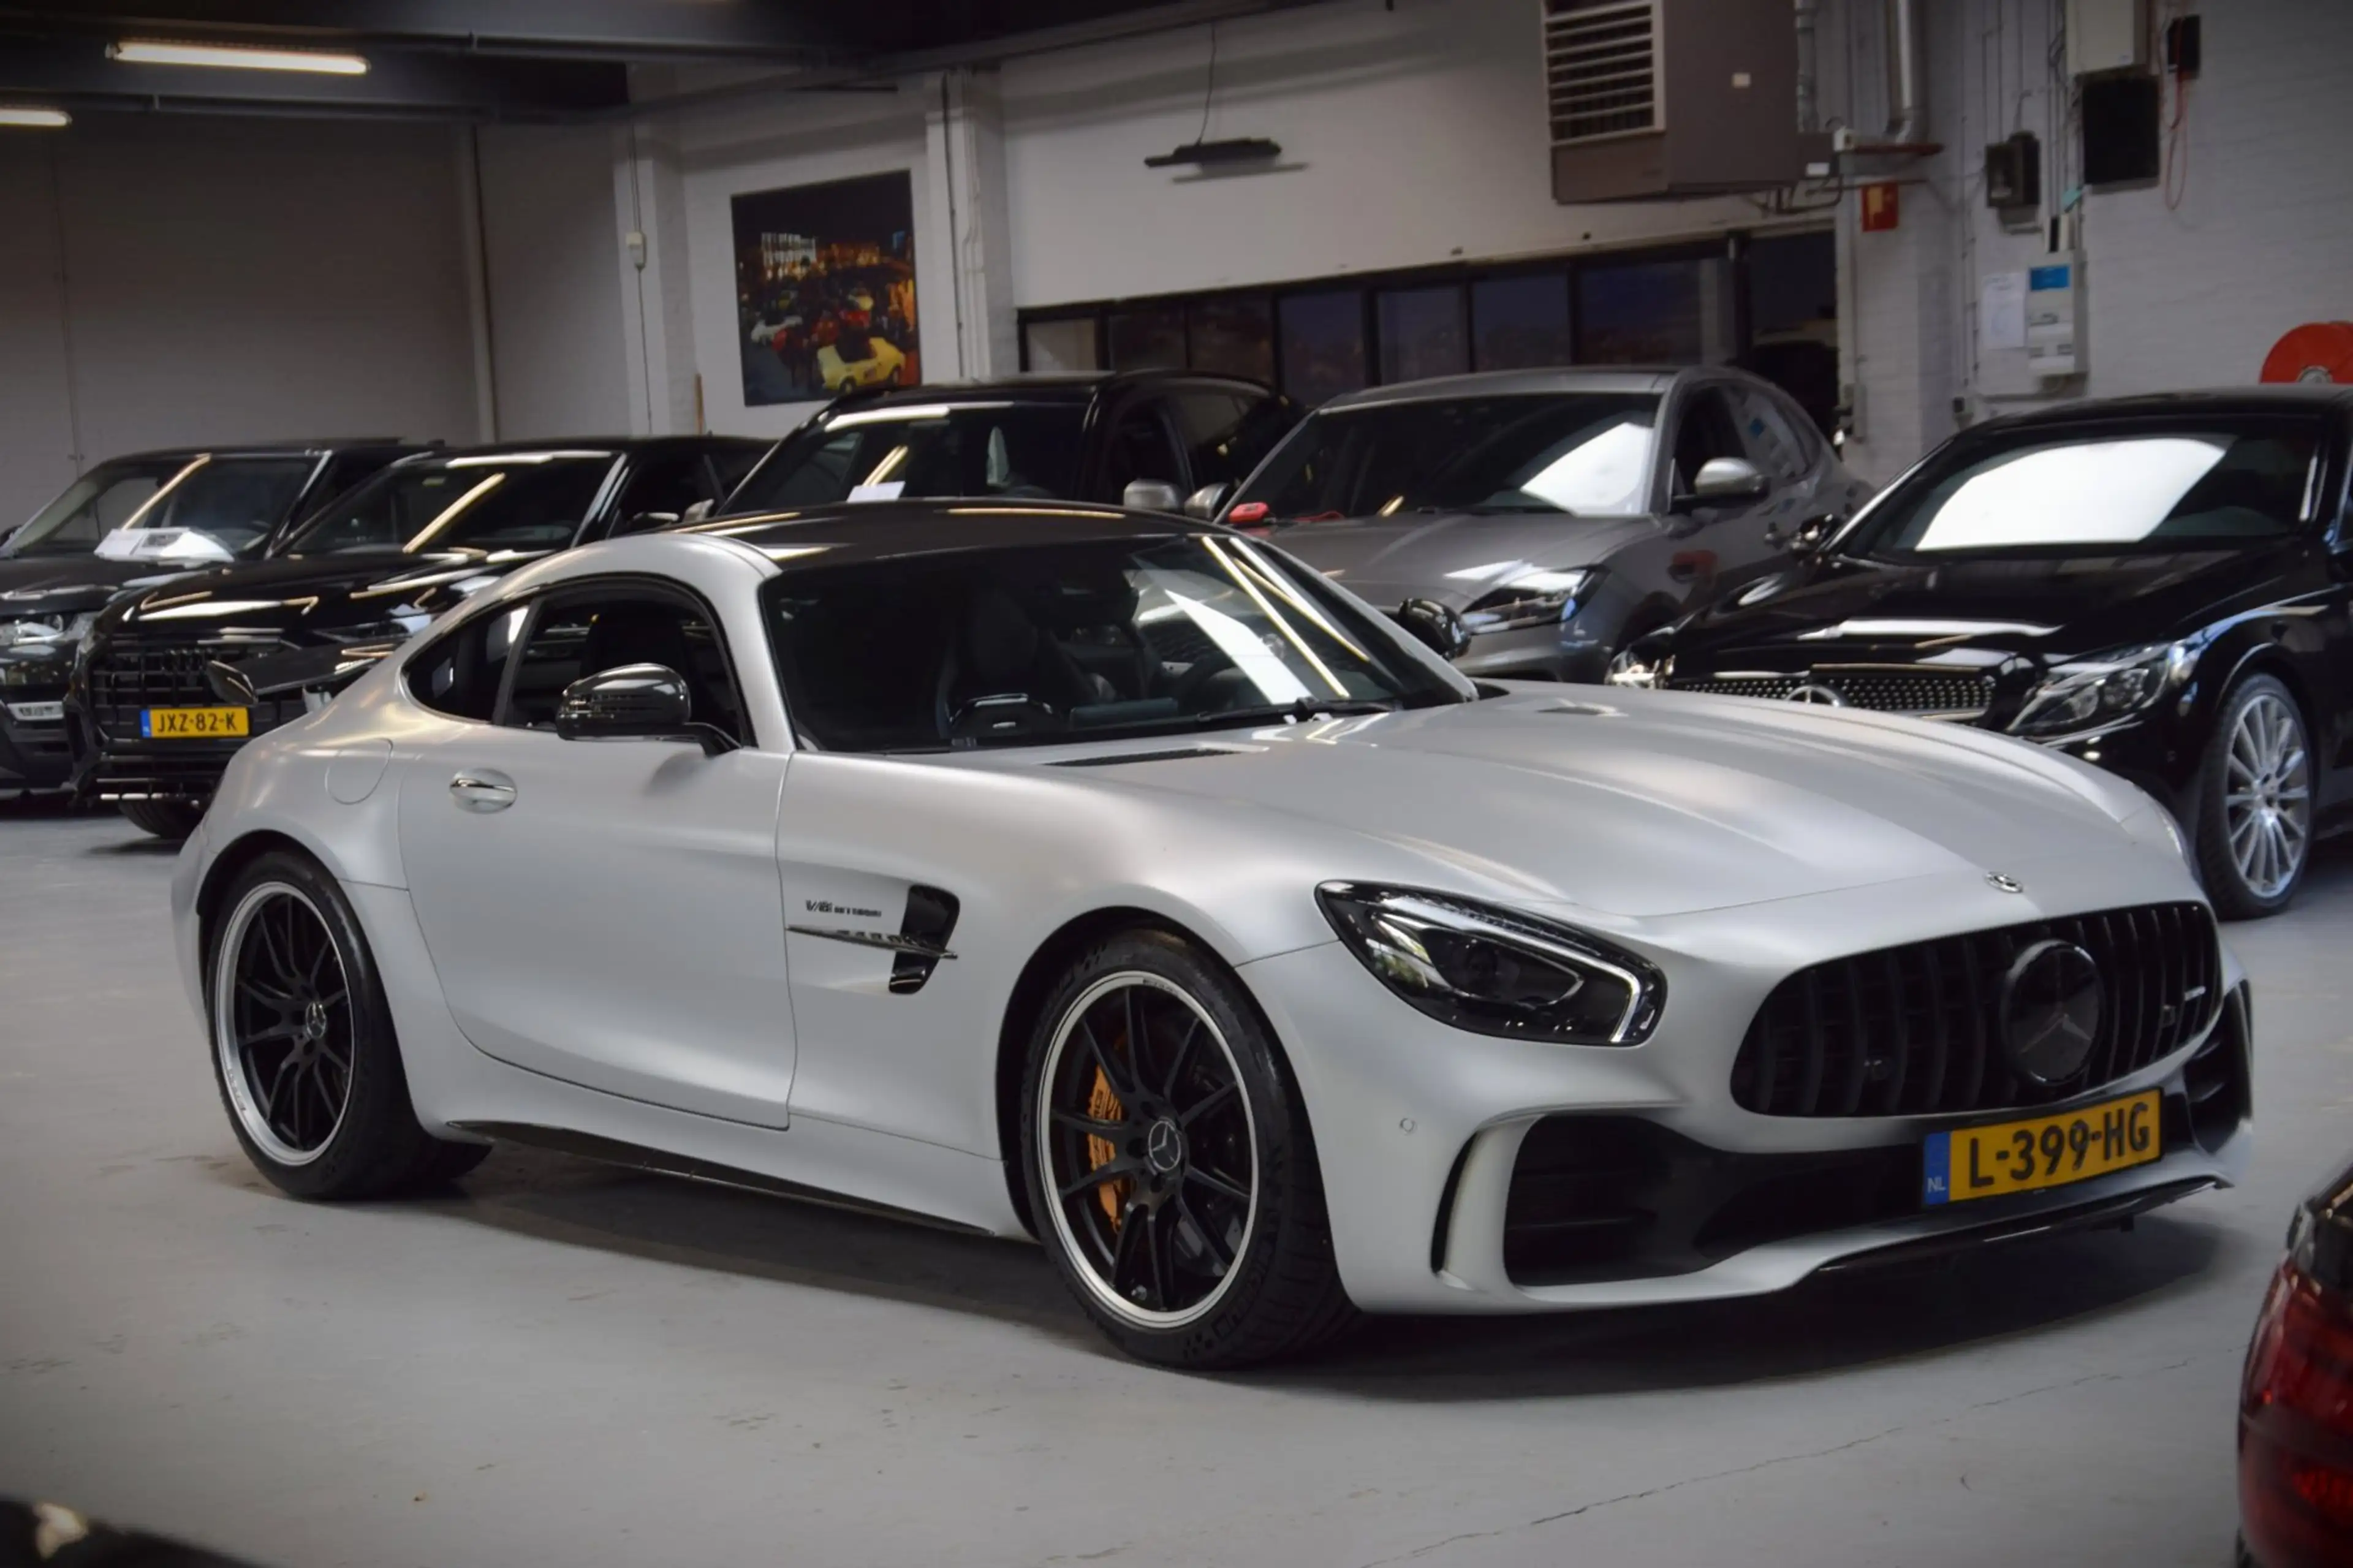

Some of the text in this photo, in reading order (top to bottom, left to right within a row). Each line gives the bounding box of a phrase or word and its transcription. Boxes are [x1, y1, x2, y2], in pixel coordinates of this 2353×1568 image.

[157, 713, 237, 733] JXZ-82-K
[1969, 1102, 2150, 1189] L-399-HG
[1927, 1177, 1946, 1193] NL
